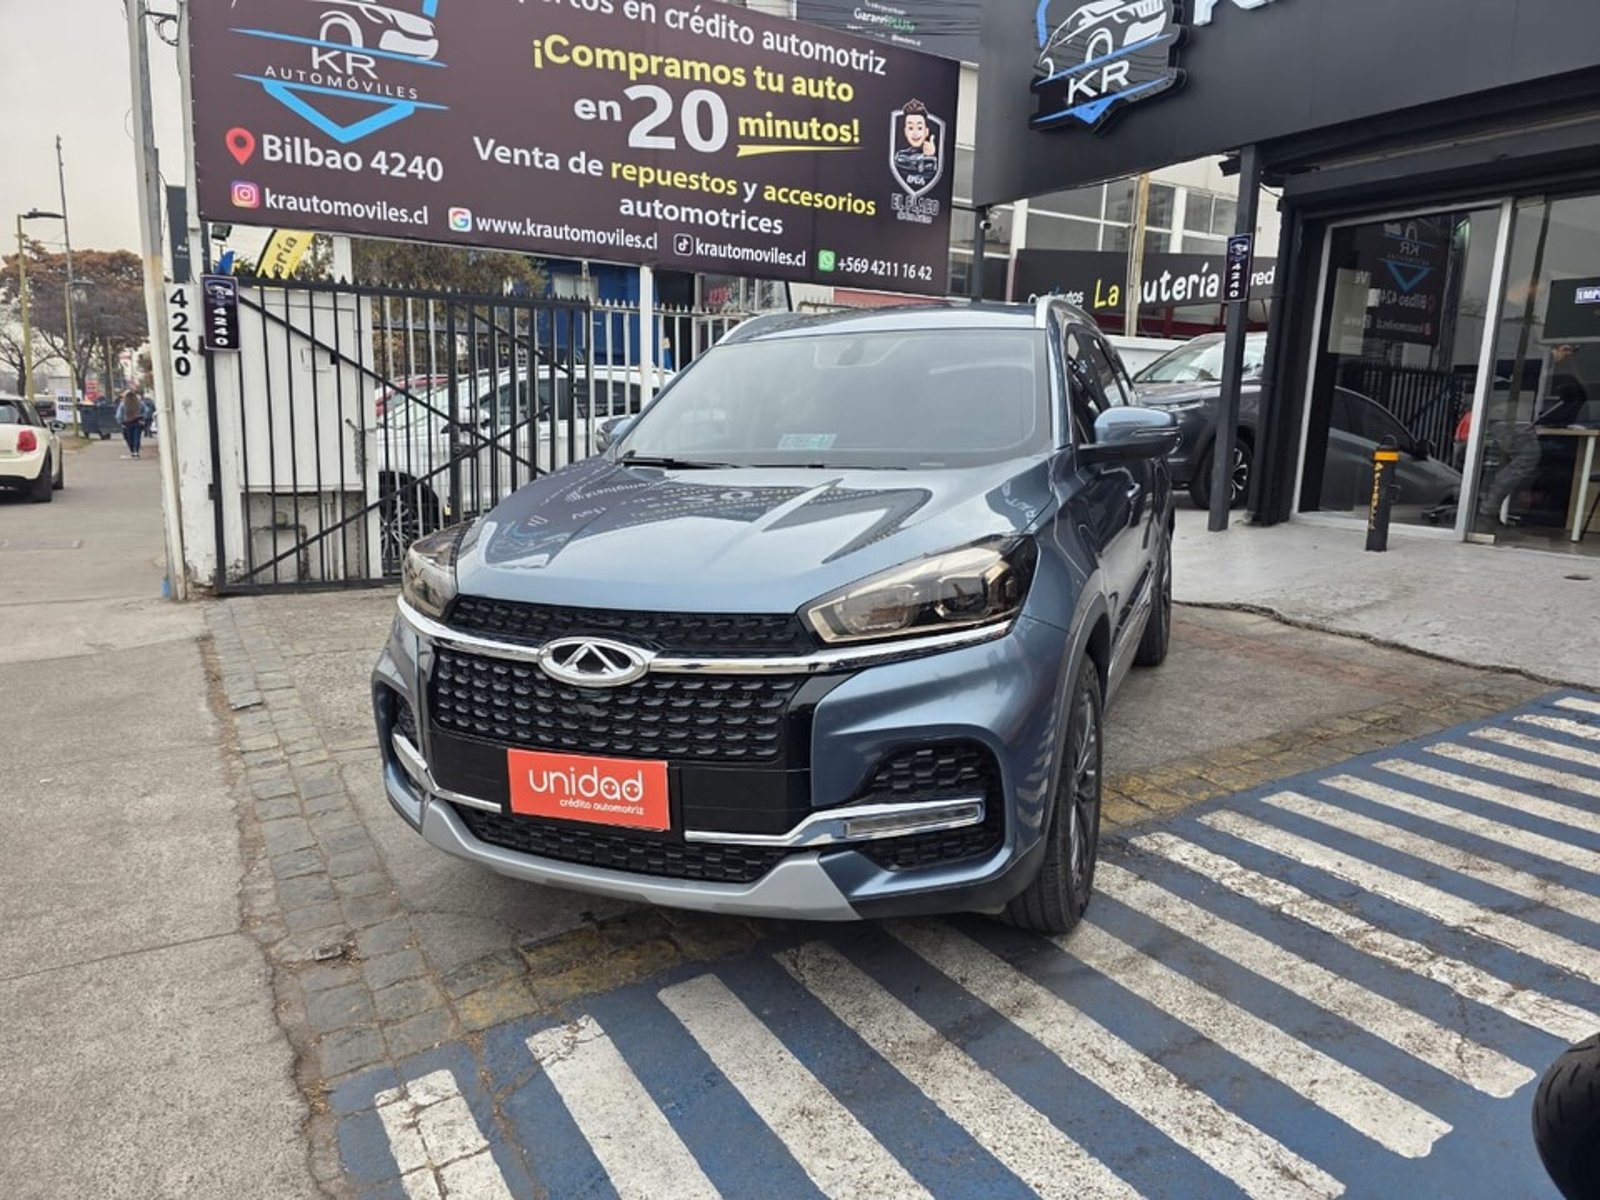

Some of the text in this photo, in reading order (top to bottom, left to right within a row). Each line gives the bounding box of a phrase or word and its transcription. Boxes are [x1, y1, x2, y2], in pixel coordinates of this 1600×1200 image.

[623, 0, 887, 76] en crédito automotriz
[311, 46, 378, 79] KR
[533, 33, 854, 102] ¡Compramos tu auto
[1067, 60, 1129, 104] KR
[264, 65, 418, 100] AUTOMÓVILES
[574, 84, 860, 153] en 20 minutos!
[262, 134, 443, 182] Bilbao 4240
[474, 136, 560, 171] Venta
[568, 148, 604, 177] de
[611, 160, 737, 198] repuestos
[743, 180, 758, 201] y
[764, 183, 876, 216] accesorios
[265, 188, 428, 225] krautomoviles.cl
[619, 195, 784, 235] automotrices
[476, 215, 658, 251] www.krautomoviles.cl
[696, 237, 807, 268] krautomoviles.cl
[838, 257, 932, 280] +569 4211 16 42
[1094, 279, 1119, 308] La
[1138, 263, 1219, 304] utería
[1229, 263, 1241, 297] 4240
[170, 288, 191, 376] 4240
[213, 307, 228, 346] 4240
[528, 766, 643, 802] unidad
[560, 798, 645, 816] crédito automotriz
